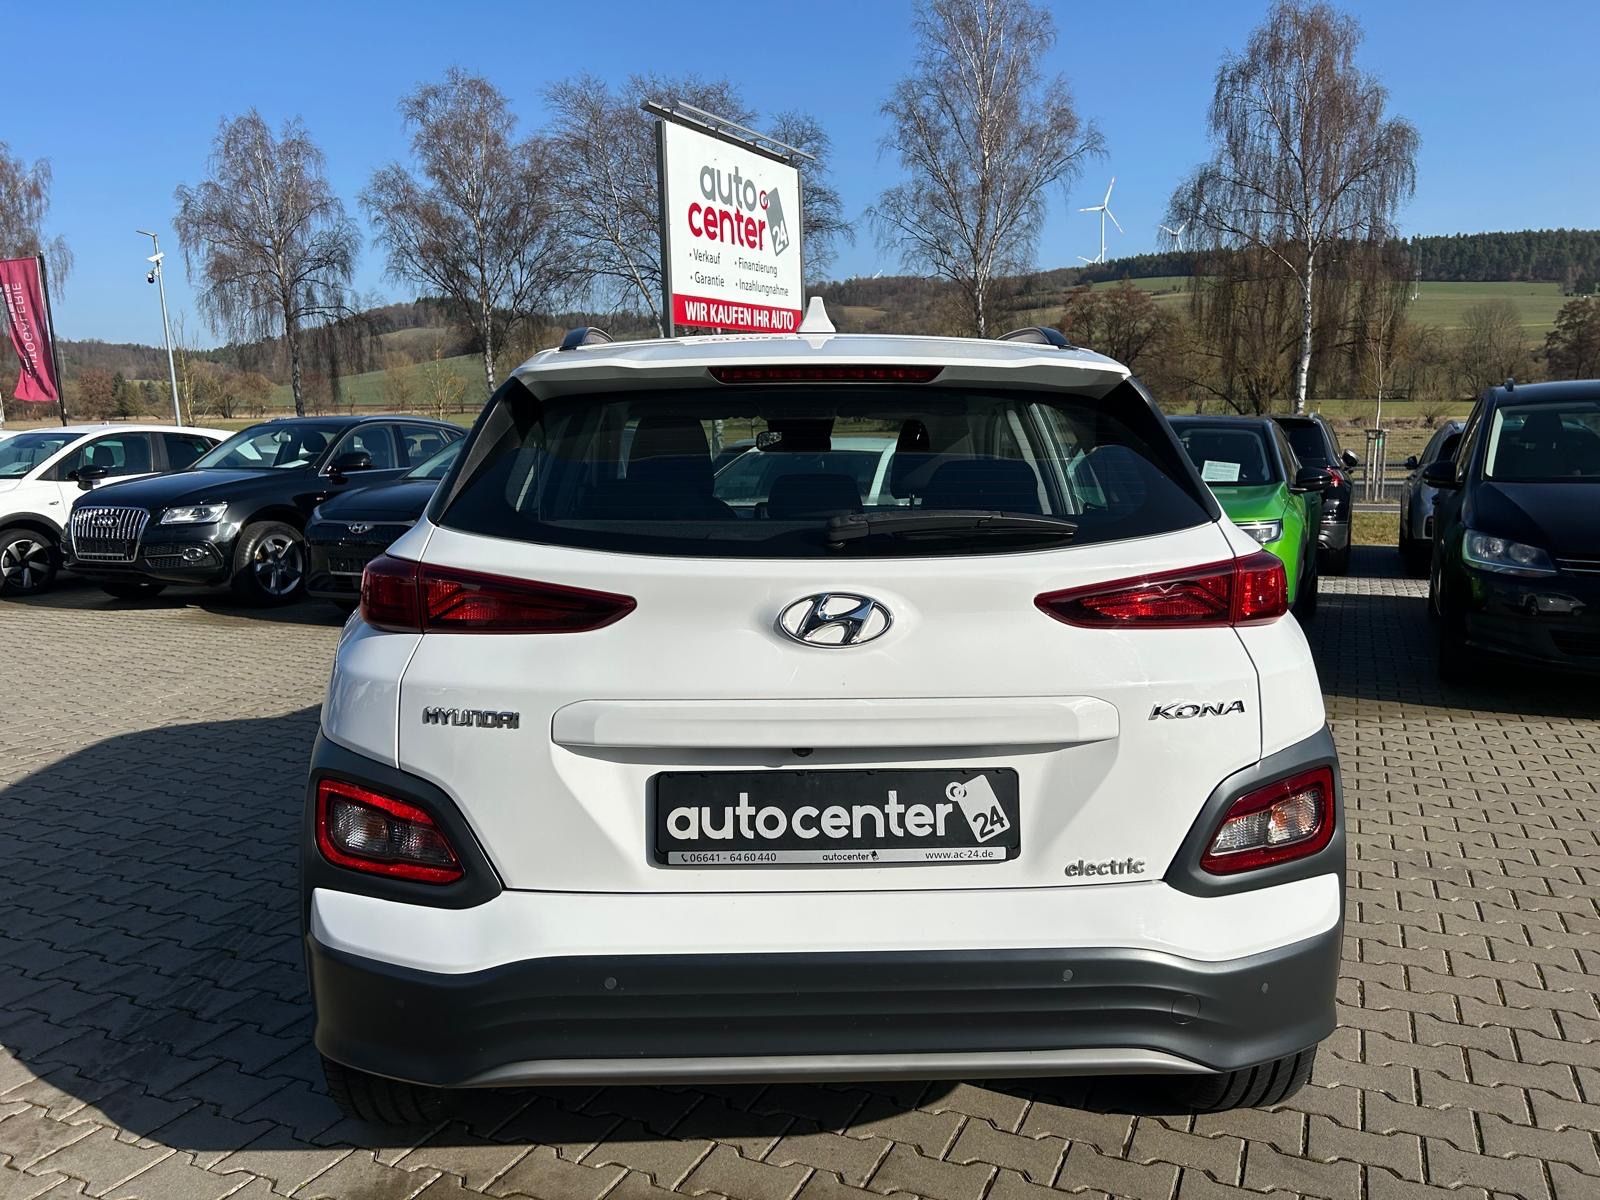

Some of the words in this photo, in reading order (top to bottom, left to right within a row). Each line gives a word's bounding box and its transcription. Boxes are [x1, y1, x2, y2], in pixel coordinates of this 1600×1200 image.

[700, 165, 757, 212] auto
[687, 202, 766, 251] center
[772, 221, 788, 252] 24
[692, 248, 721, 265] Verkauf
[738, 257, 778, 278] Finanzierung
[694, 271, 725, 288] Garantie
[739, 278, 789, 297] Inzahlungnahme
[684, 300, 708, 322] WIR
[709, 303, 752, 326] KAUFEN
[753, 308, 770, 328] IHR
[770, 309, 795, 331] AUTO
[422, 706, 520, 730] HYUNDAI
[1148, 699, 1246, 721] KONA
[973, 804, 1005, 839] 24
[689, 852, 720, 863] 06641
[822, 852, 869, 861] autocenter
[925, 849, 994, 860] www.ac-24.de
[1064, 857, 1145, 877] electric
